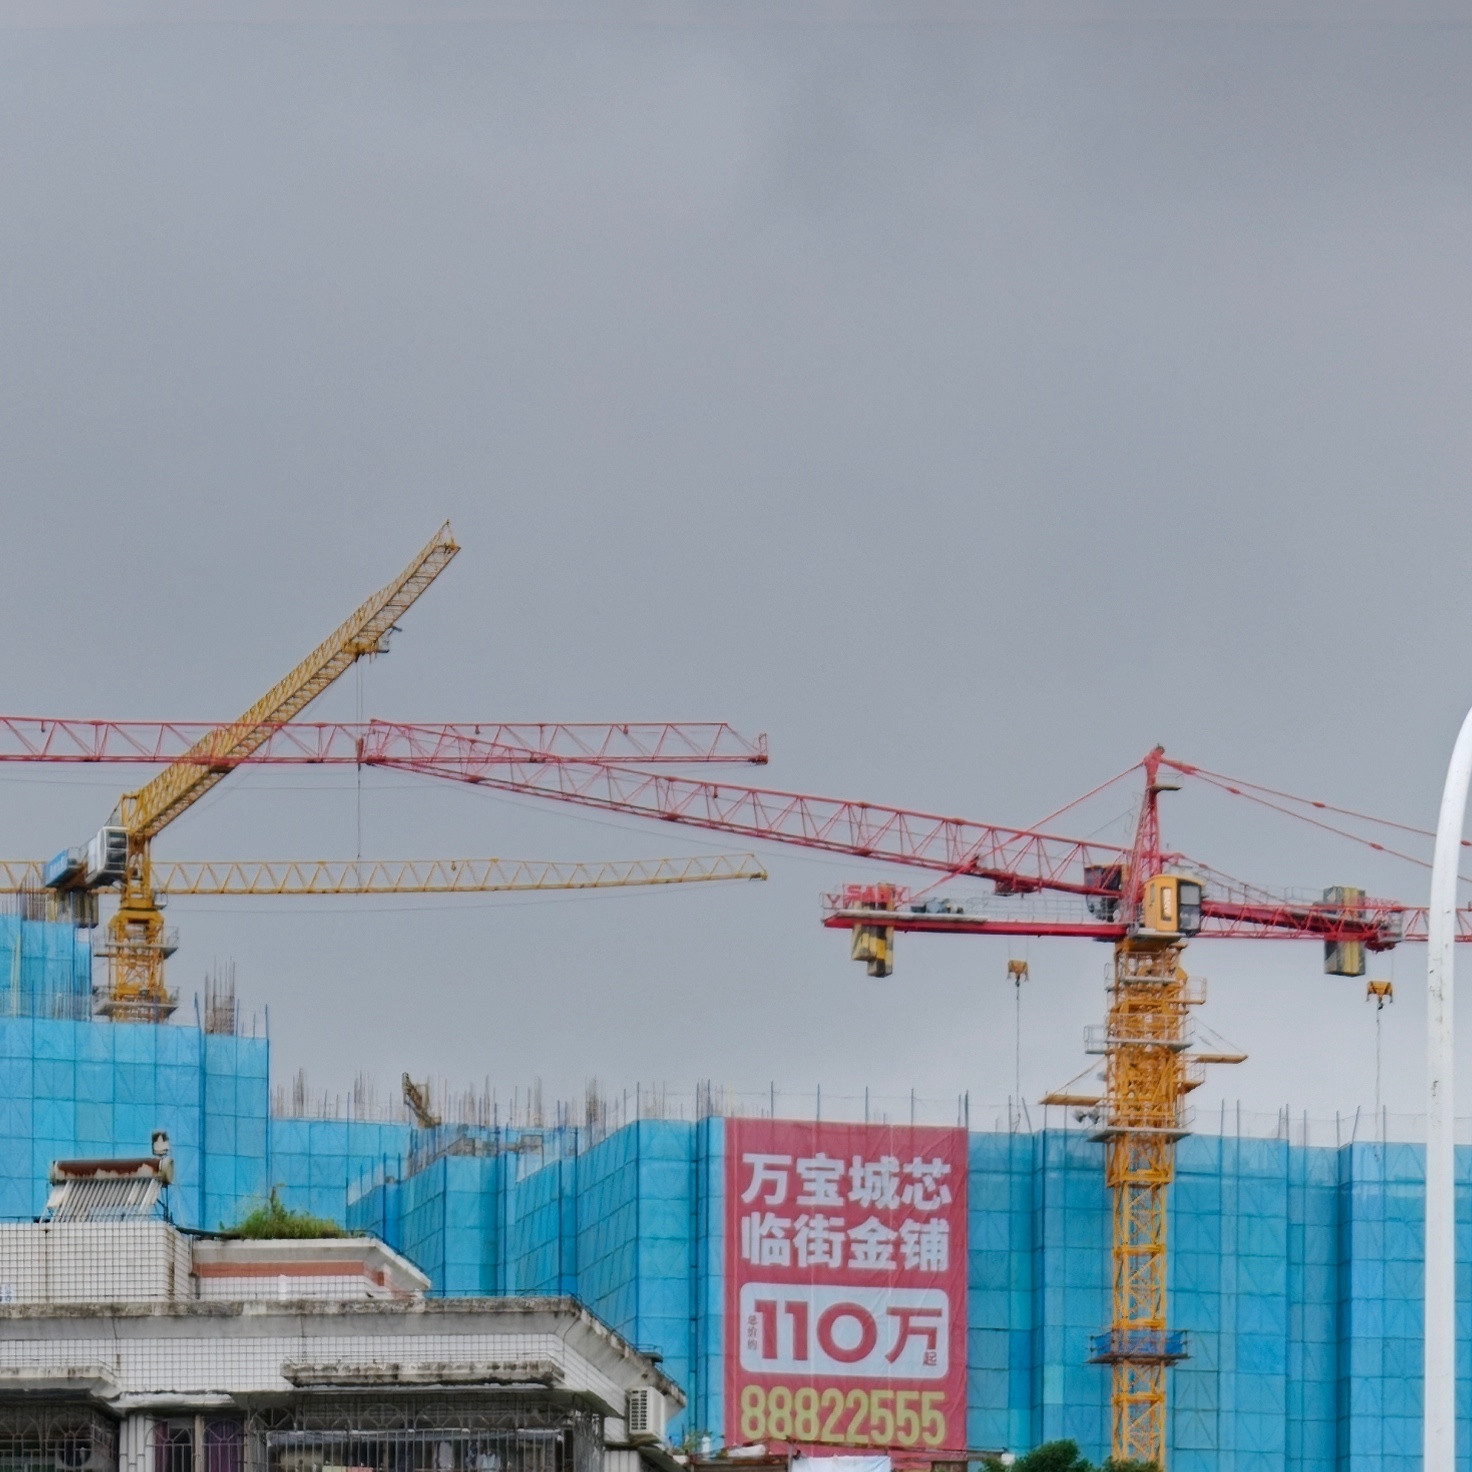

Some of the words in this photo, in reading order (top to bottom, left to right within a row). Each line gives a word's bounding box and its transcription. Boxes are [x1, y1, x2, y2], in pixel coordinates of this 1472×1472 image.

[741, 1152, 952, 1211] 万宝城芯
[741, 1211, 949, 1272] 临街金铺
[741, 1384, 946, 1446] 88822555
